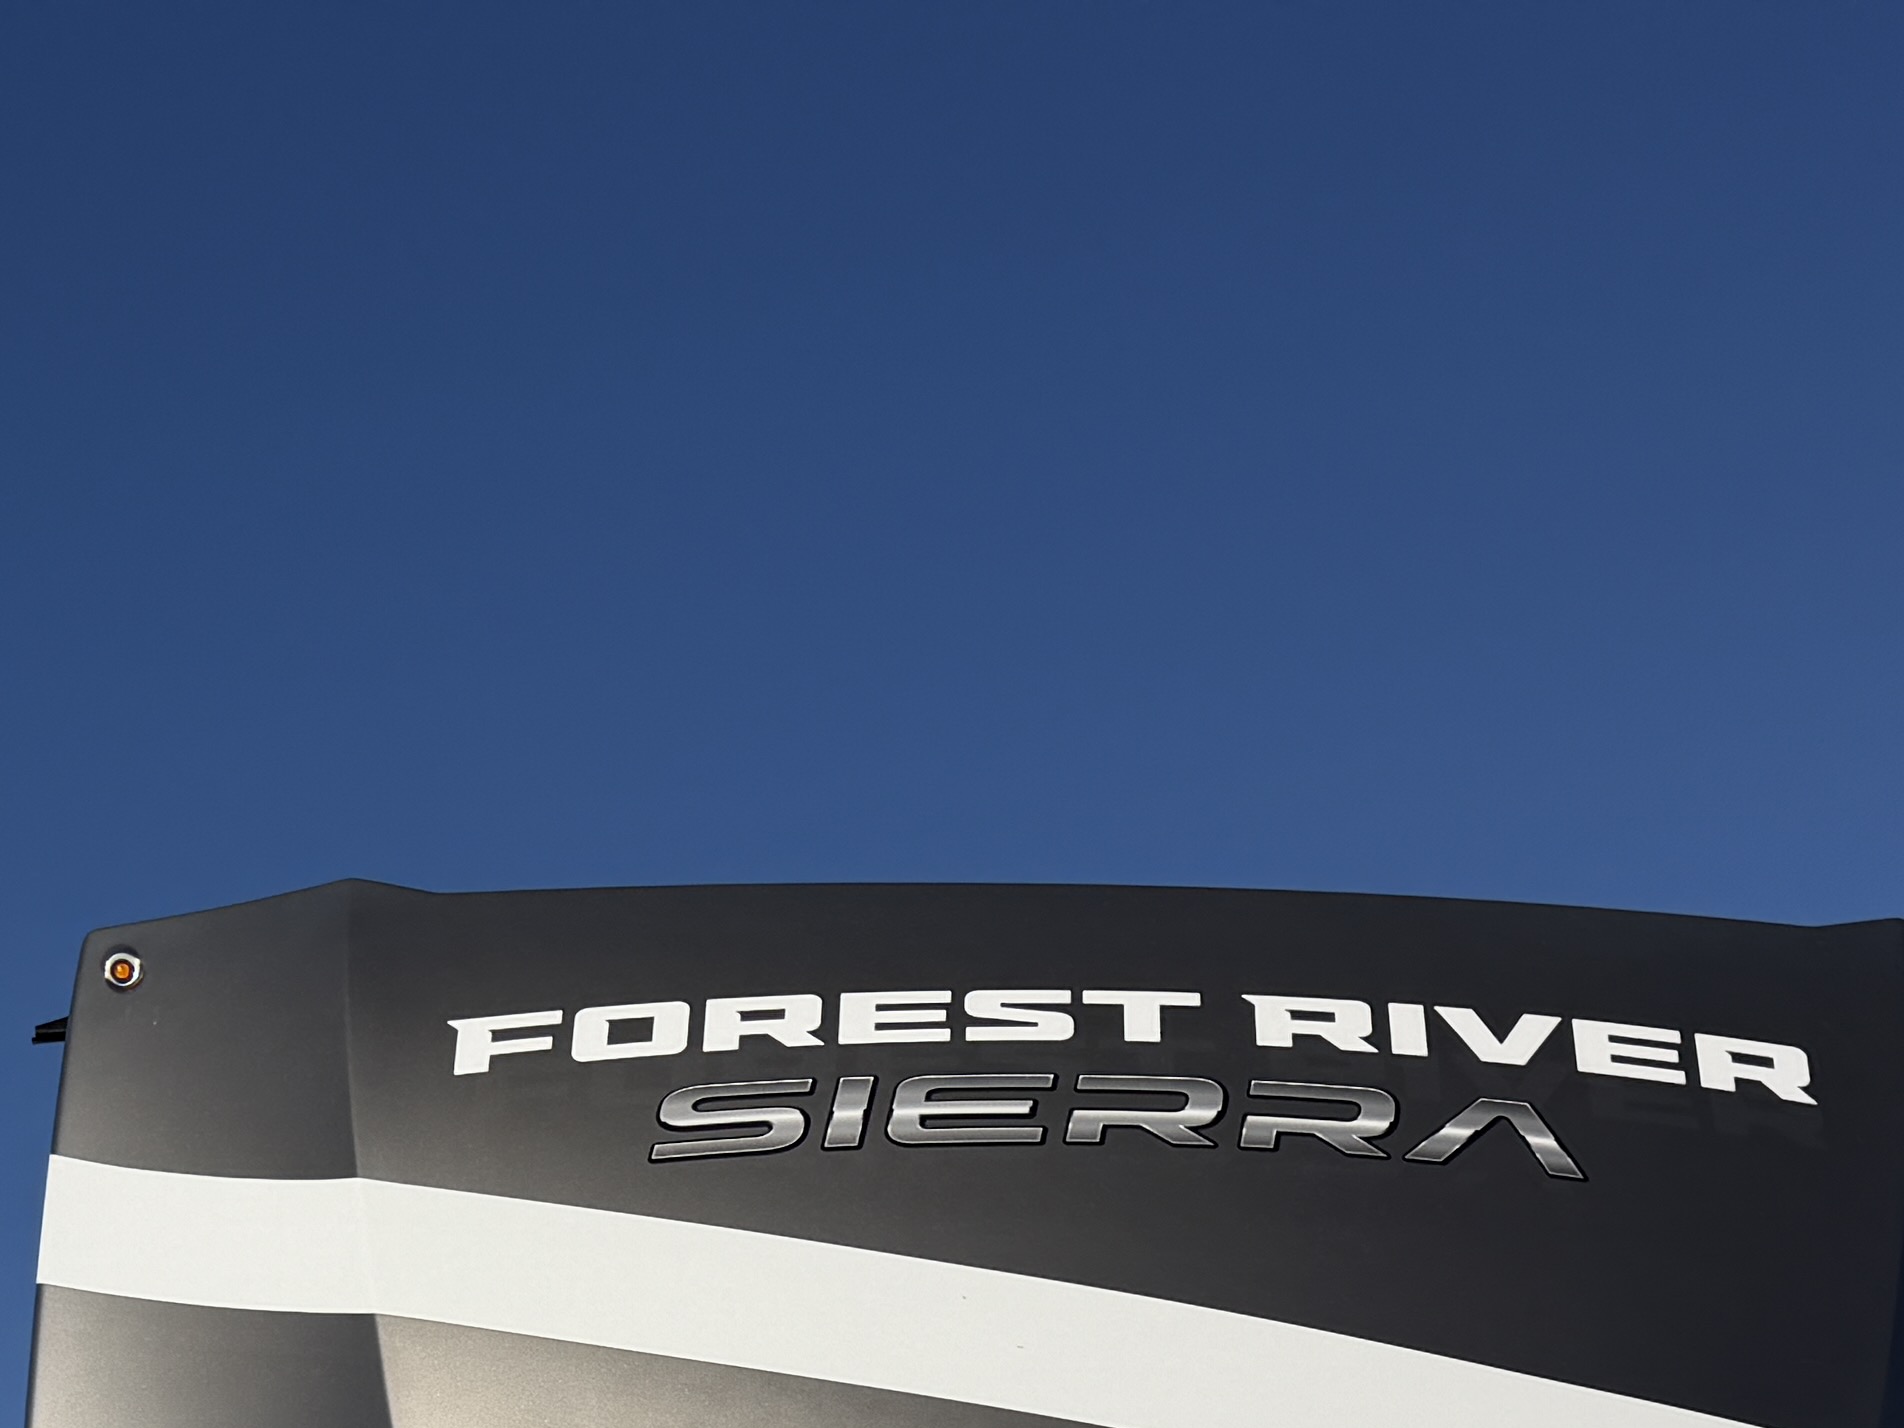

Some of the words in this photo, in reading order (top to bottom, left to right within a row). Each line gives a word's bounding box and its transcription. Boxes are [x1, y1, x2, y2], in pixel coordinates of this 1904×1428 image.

[447, 990, 1200, 1076] FOREST
[1242, 995, 1818, 1105] RIVER
[647, 1071, 1590, 1184] SIERRA
